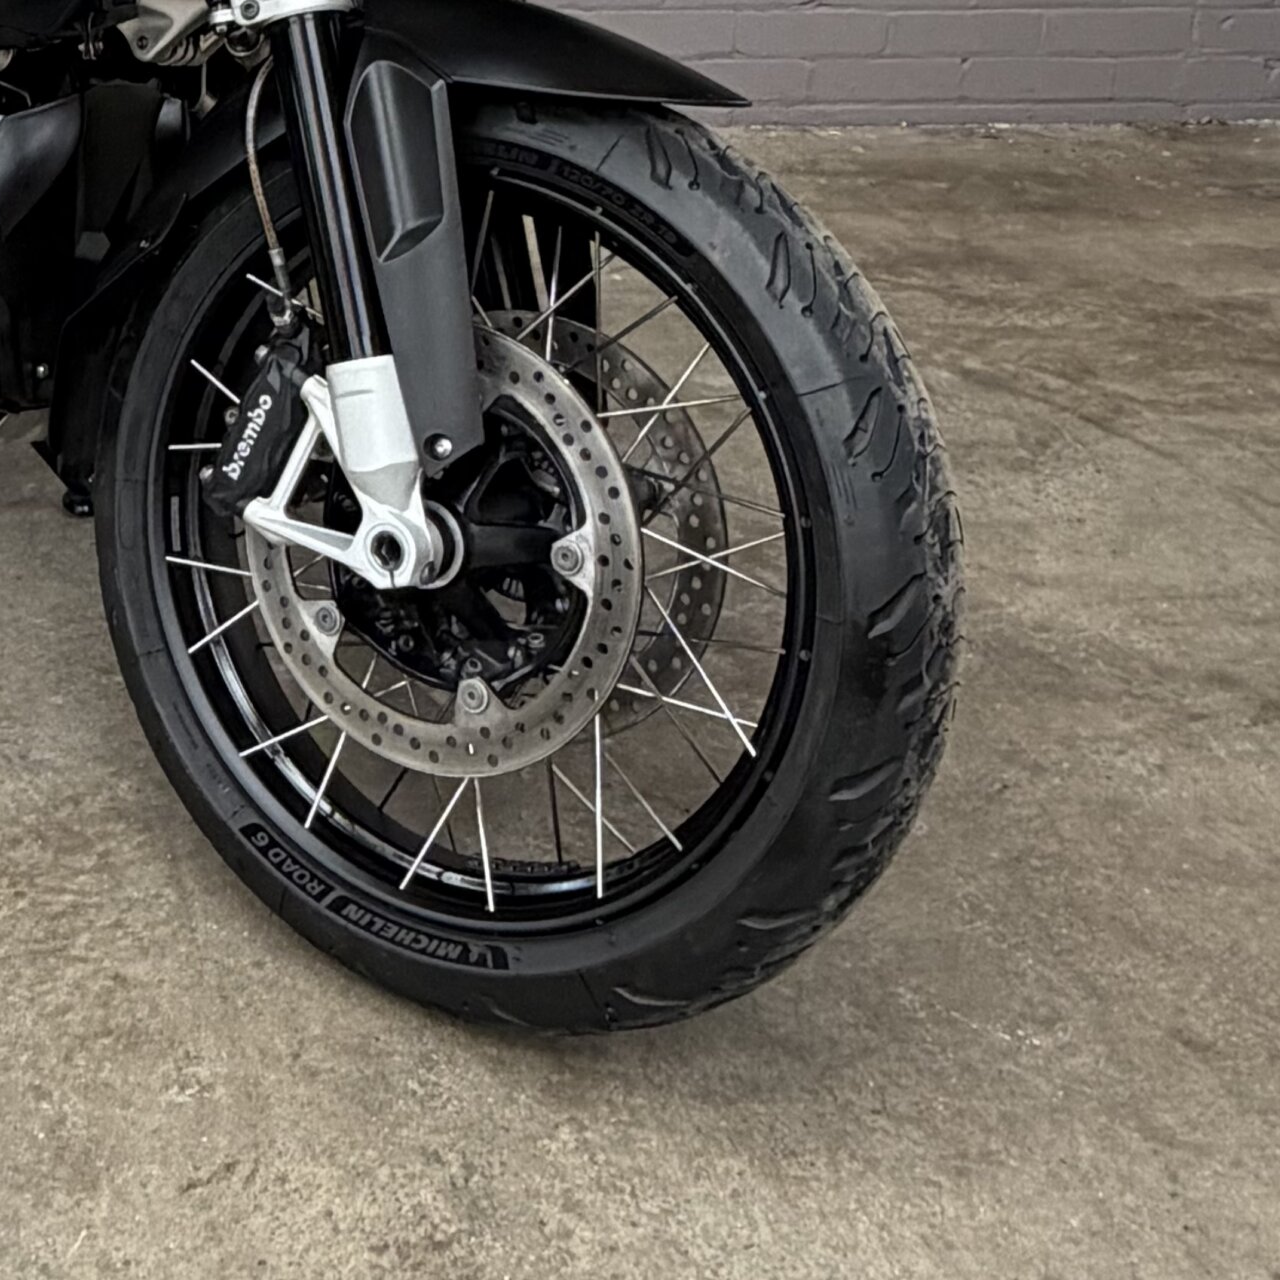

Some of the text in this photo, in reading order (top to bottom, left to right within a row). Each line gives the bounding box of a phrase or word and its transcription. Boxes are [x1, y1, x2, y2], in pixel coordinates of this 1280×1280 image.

[222, 394, 272, 482] brembo
[250, 830, 464, 961] MICHELIN ROAD 6
